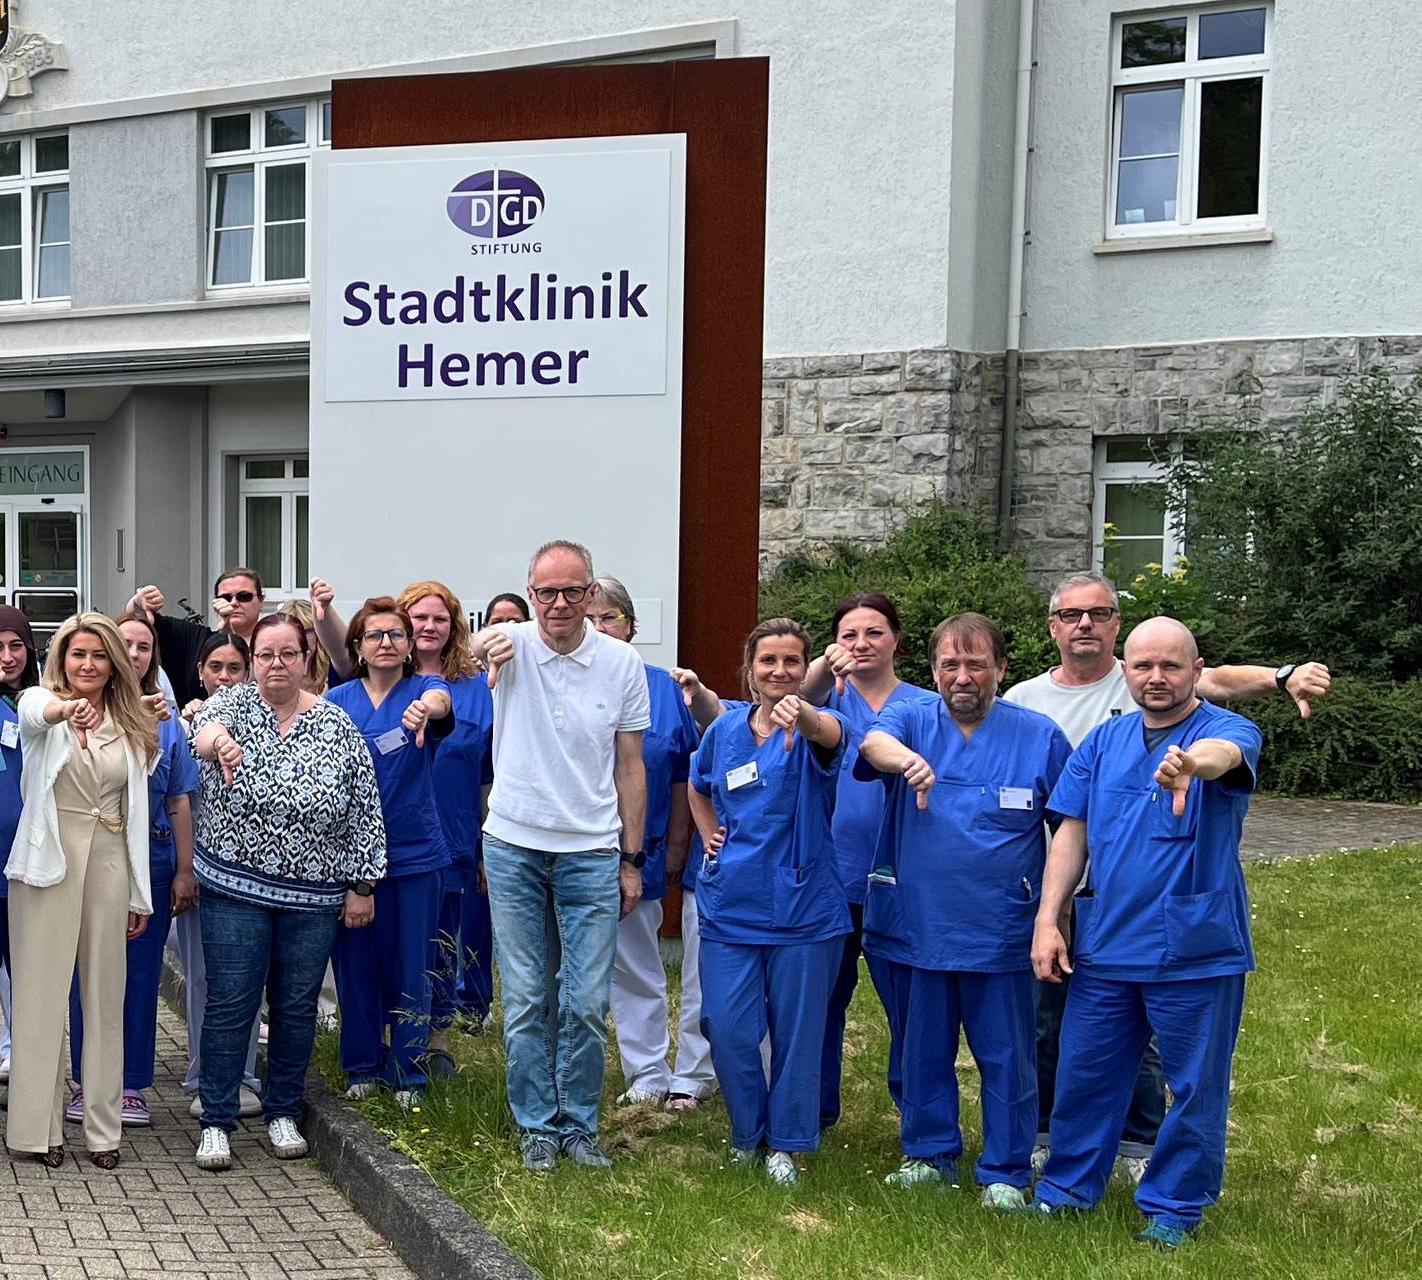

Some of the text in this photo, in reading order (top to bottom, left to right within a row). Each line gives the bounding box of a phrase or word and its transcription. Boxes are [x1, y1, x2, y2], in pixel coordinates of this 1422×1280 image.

[470, 241, 543, 256] STIFTUNG
[342, 269, 649, 327] Stadtklinik
[397, 343, 590, 388] Hemer
